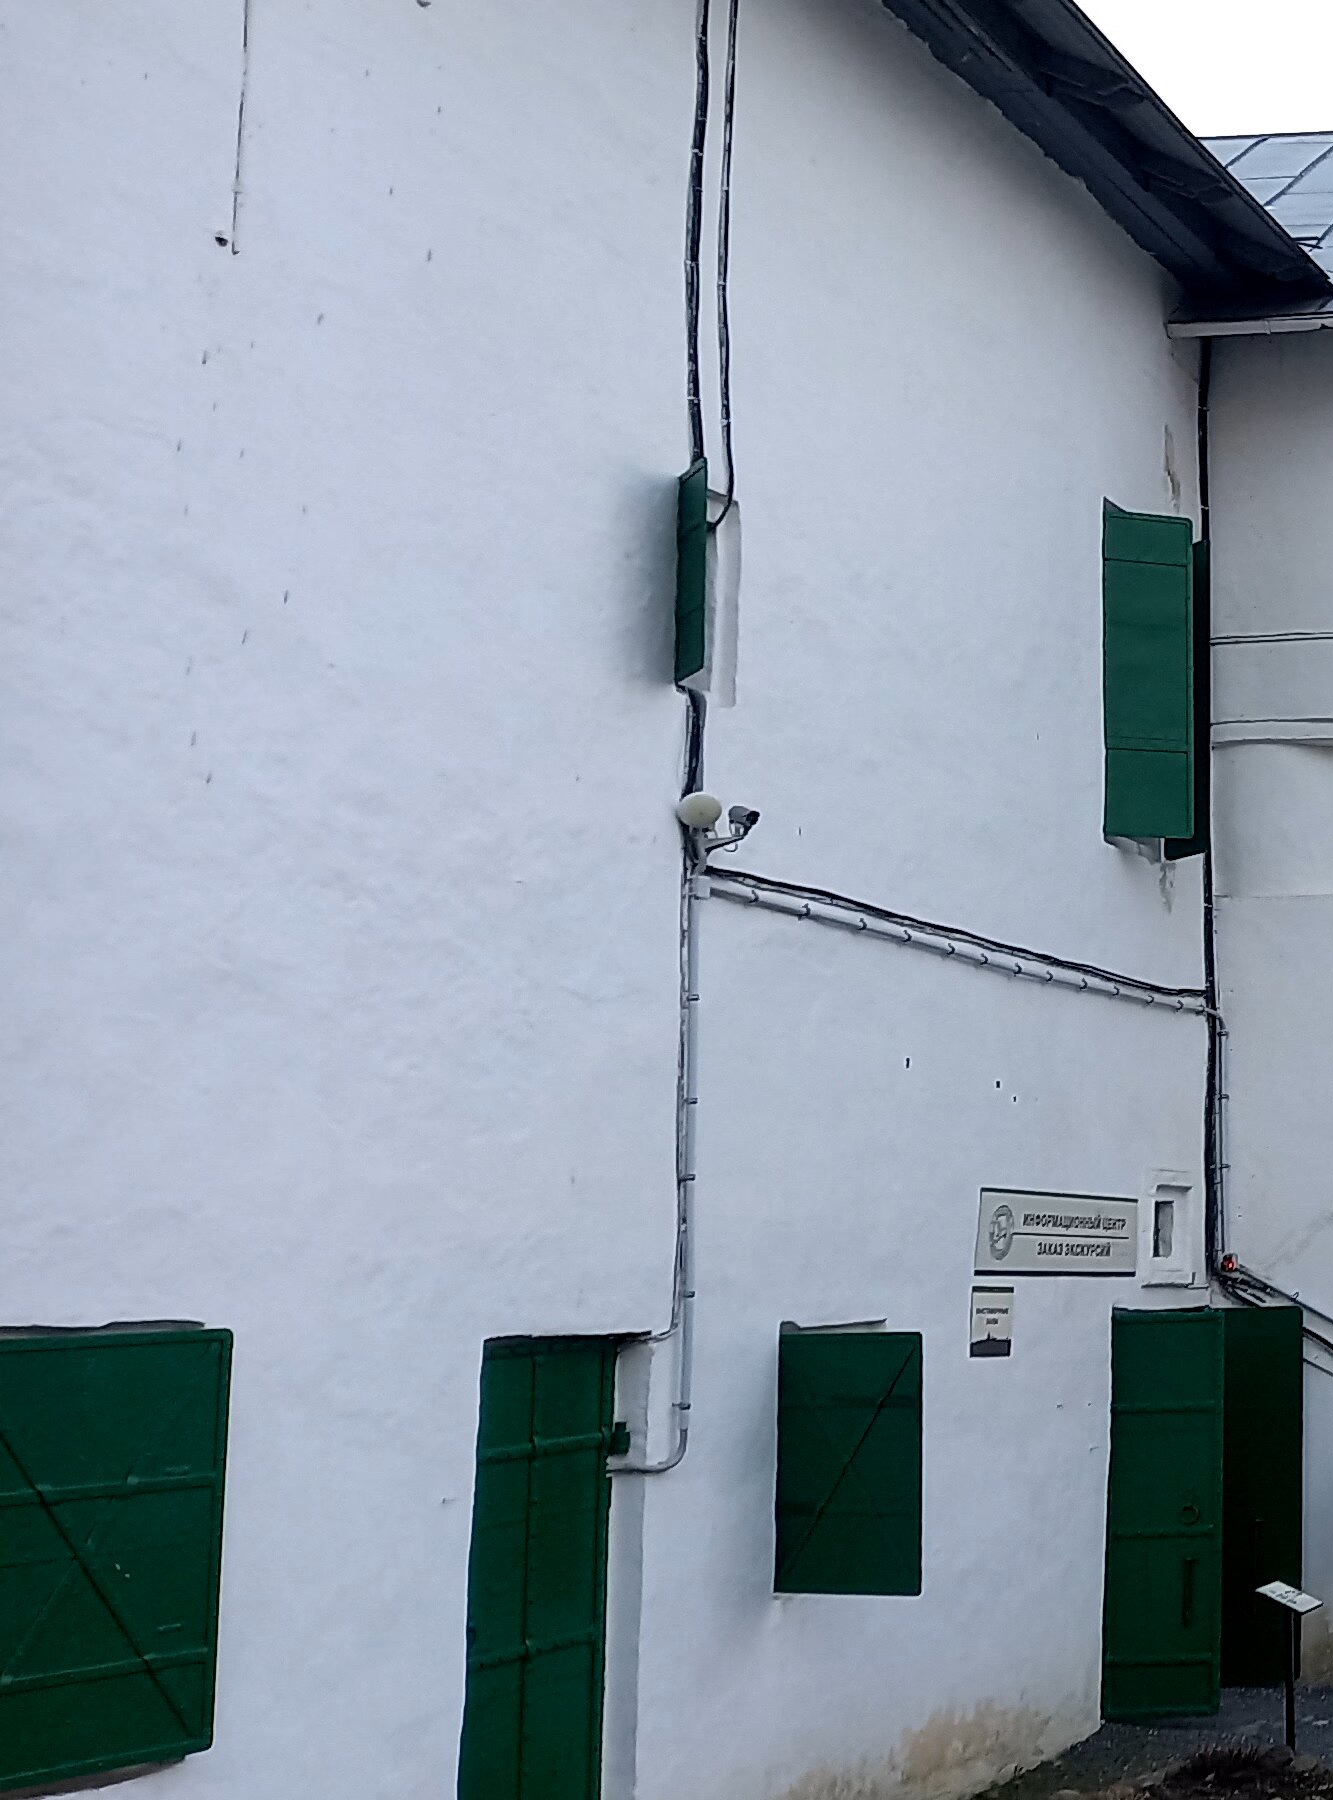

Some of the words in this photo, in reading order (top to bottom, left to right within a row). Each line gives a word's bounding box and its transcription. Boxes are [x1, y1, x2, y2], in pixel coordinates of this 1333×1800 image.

[1022, 1213, 1101, 1231] ИНФОРМАЦИОННЫЙ
[1102, 1217, 1127, 1232] ЦЕНТР
[1037, 1241, 1063, 1256] ЗАКАЗ
[1064, 1241, 1111, 1257] ЭКСКУРСИЙ
